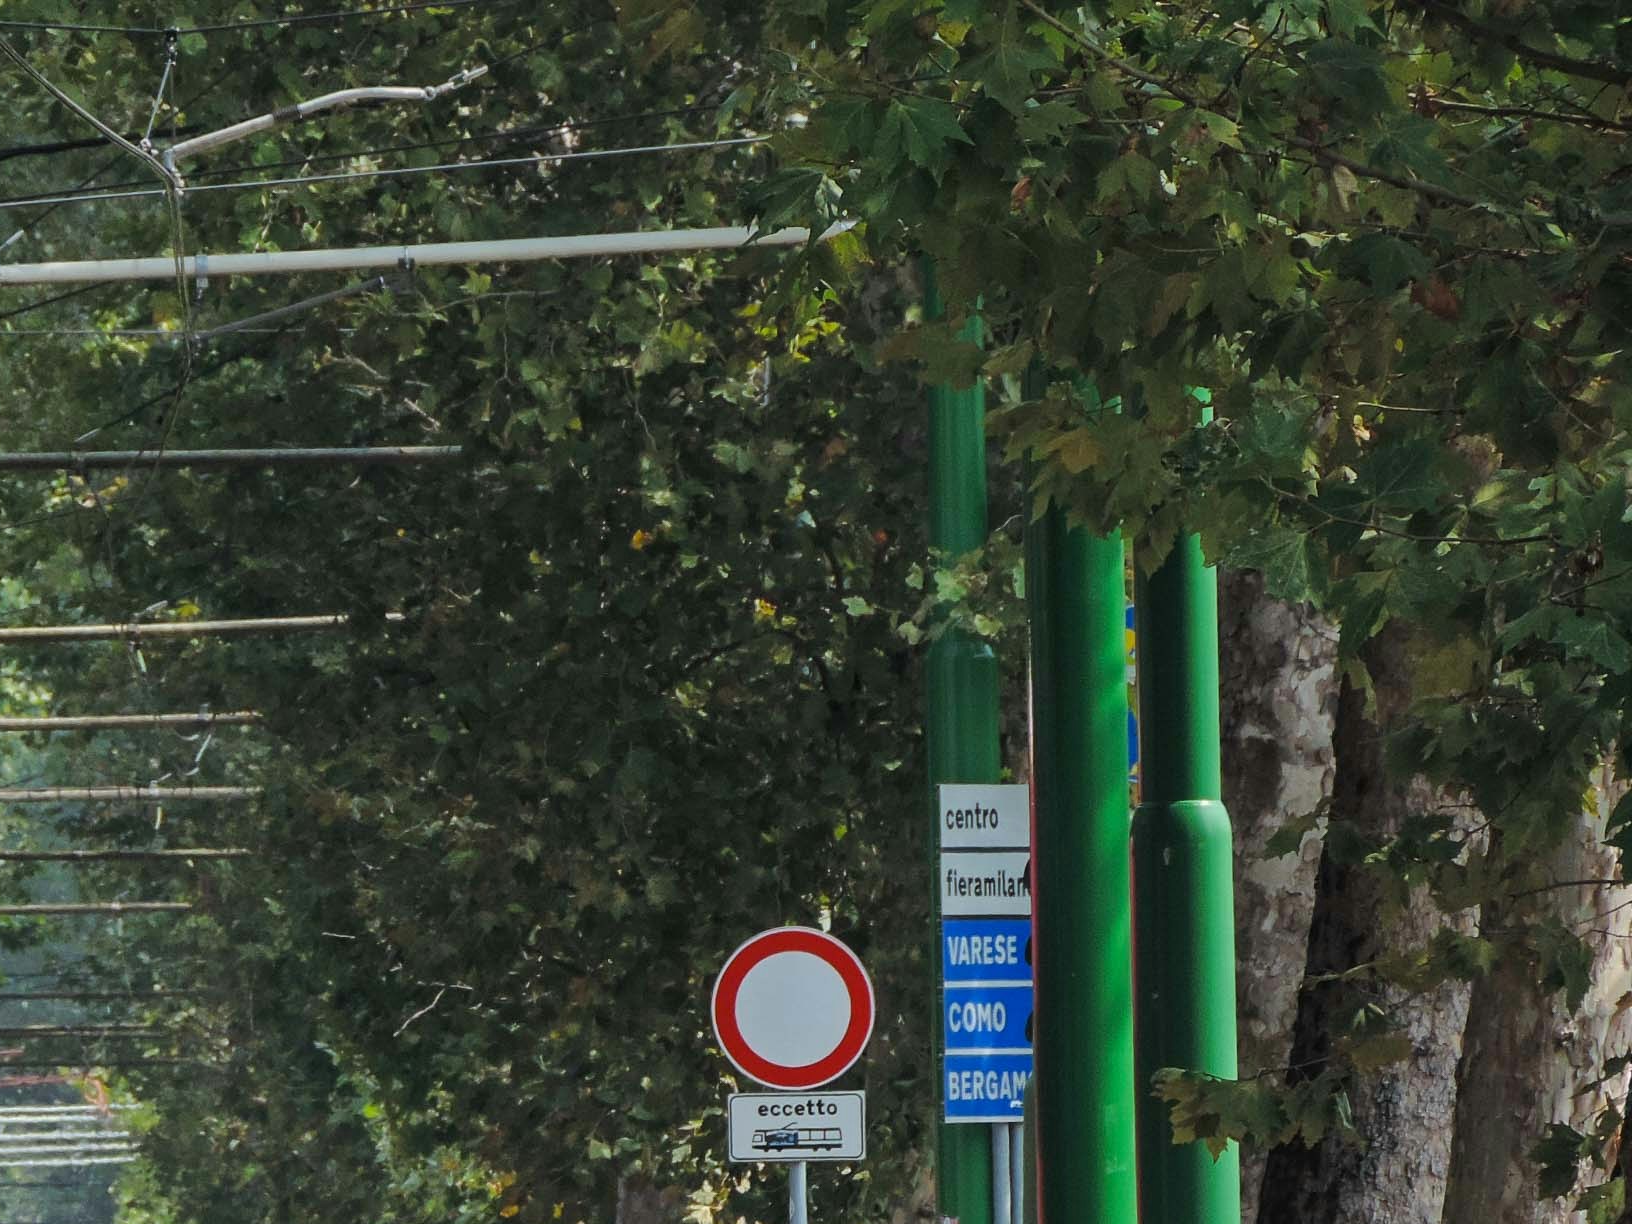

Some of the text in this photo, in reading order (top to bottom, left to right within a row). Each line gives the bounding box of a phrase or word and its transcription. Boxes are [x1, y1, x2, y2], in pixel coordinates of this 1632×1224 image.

[946, 802, 999, 830] centro
[946, 868, 1031, 897] fieramilan
[948, 935, 1018, 966] VARESE
[948, 1002, 1006, 1033] COMO
[948, 1070, 1032, 1101] BERGAM
[757, 1099, 838, 1117] eccetto
